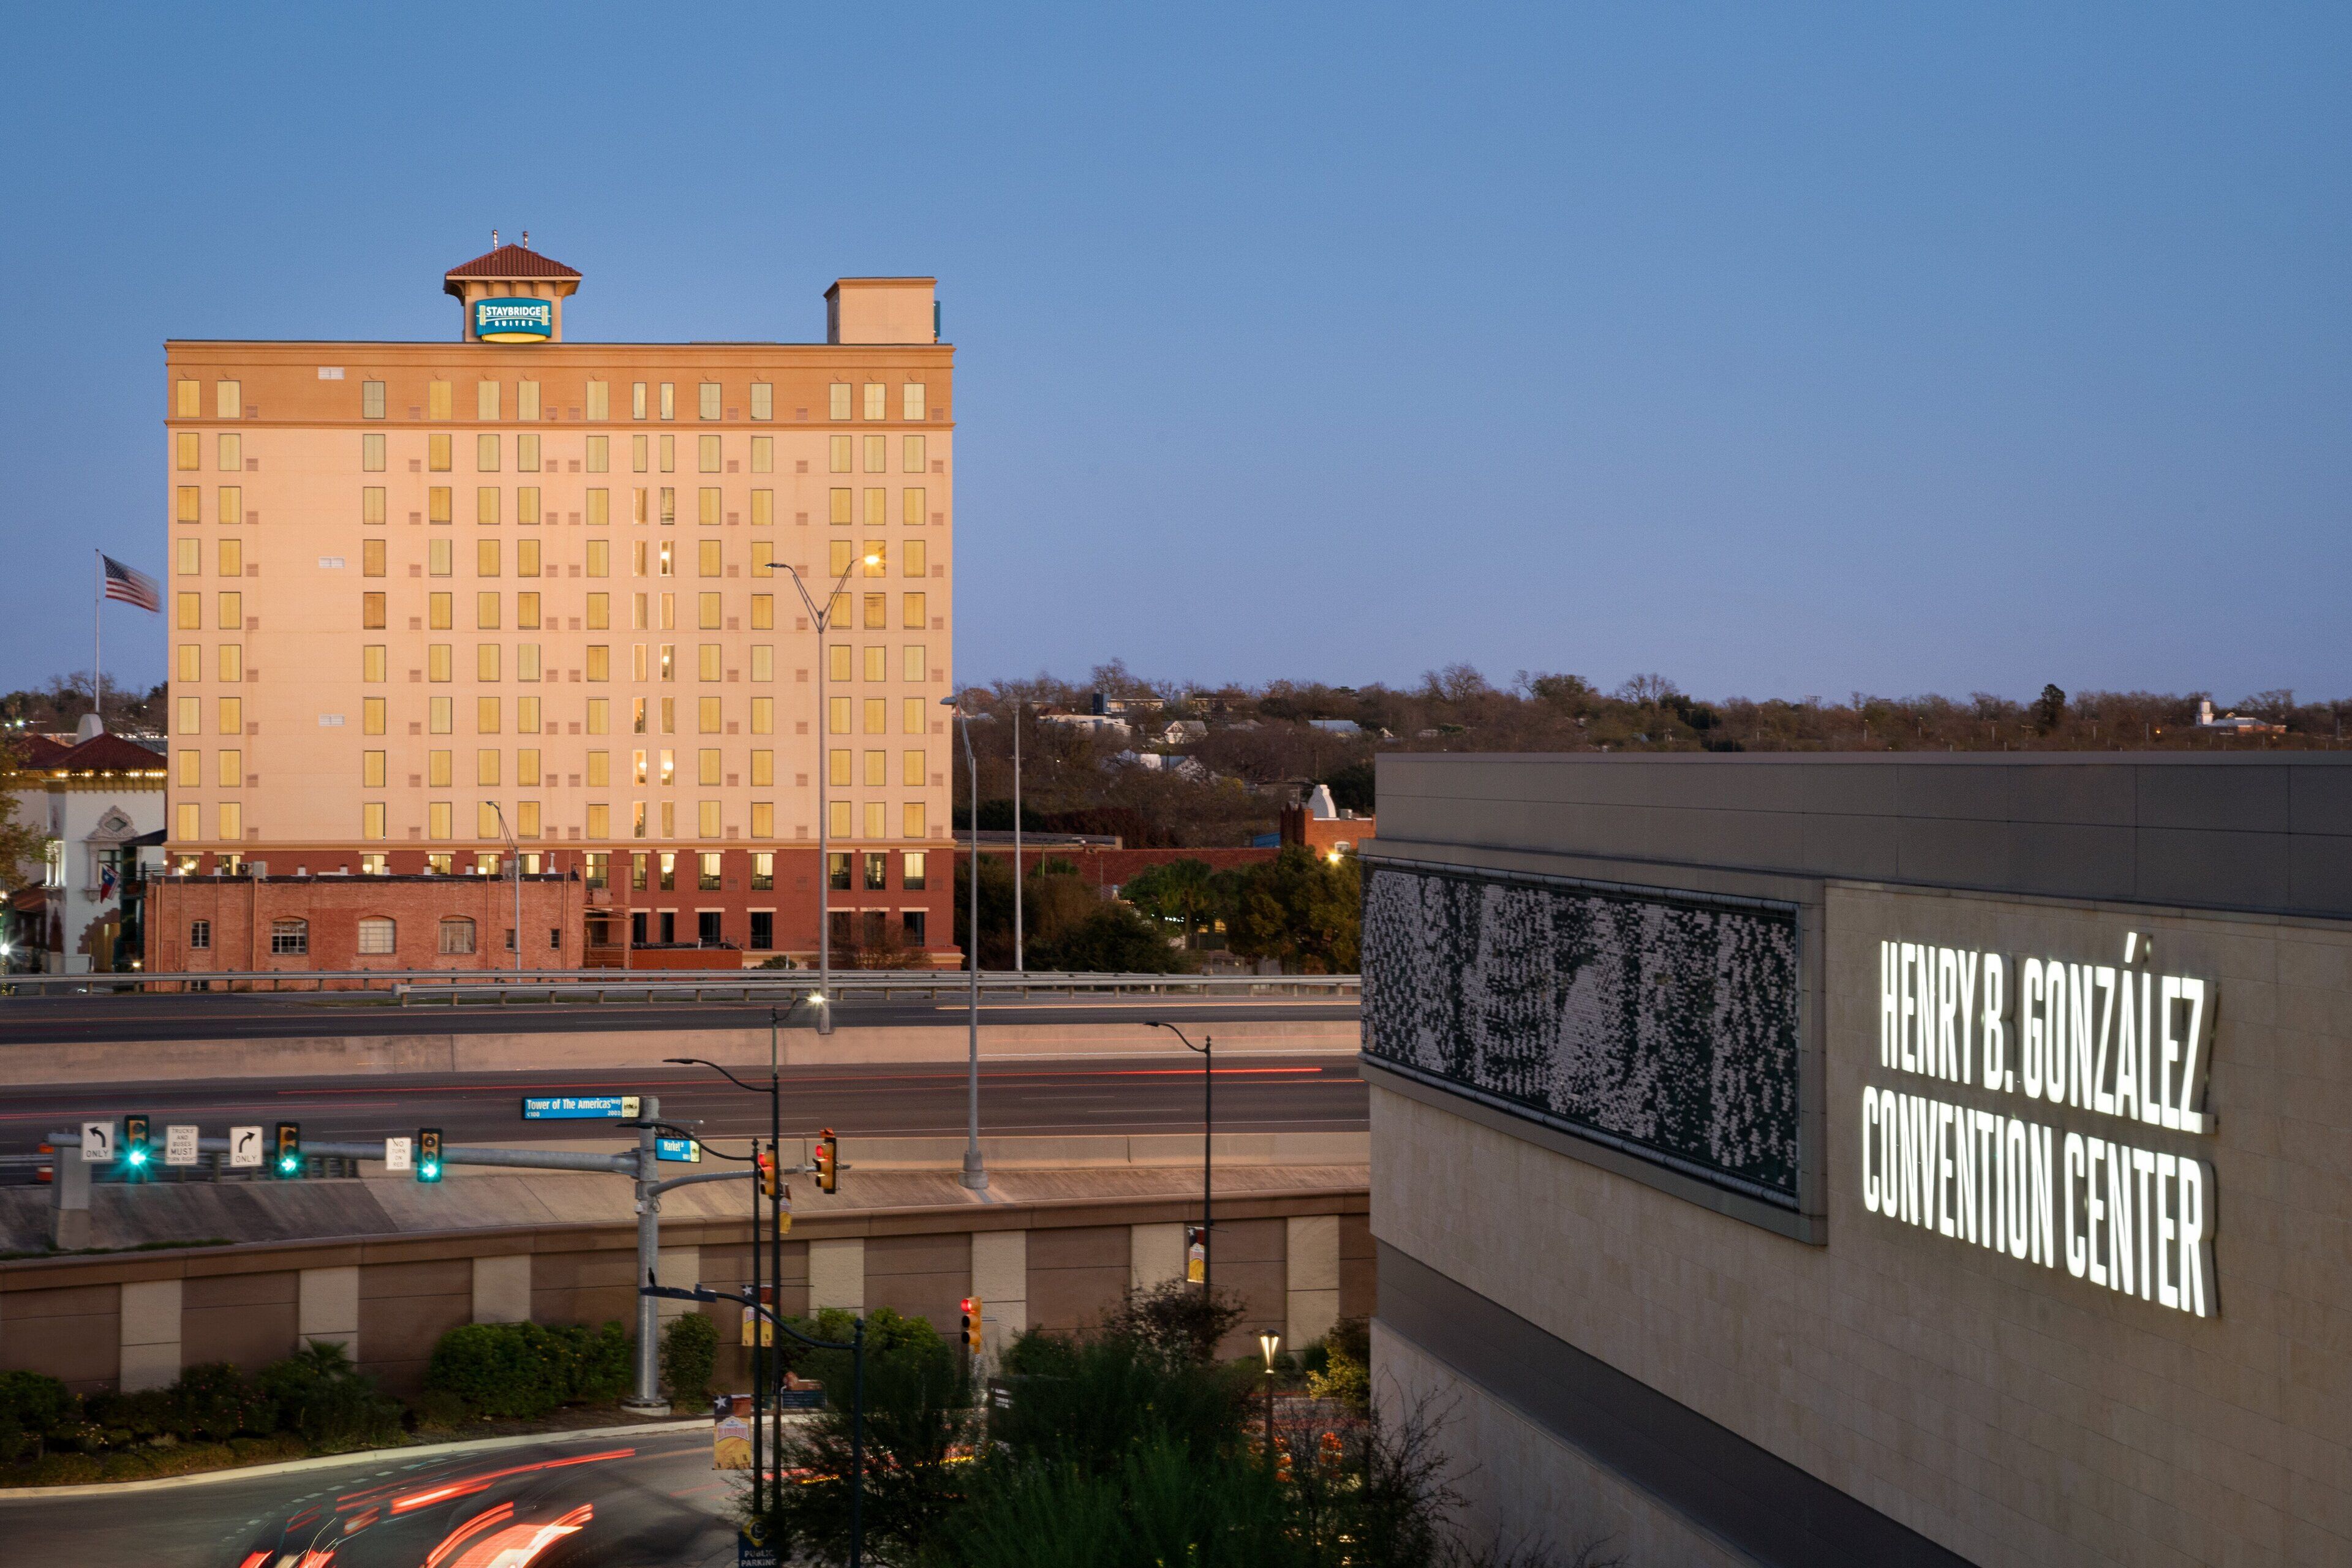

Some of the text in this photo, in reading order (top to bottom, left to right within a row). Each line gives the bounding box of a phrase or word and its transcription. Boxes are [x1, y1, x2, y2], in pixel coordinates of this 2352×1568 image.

[486, 306, 541, 315] STAYBRIDGE
[1881, 932, 2205, 1134] HENRY B. GONZÁLEZ
[527, 1099, 550, 1110] Tower
[552, 1099, 560, 1109] of
[562, 1099, 575, 1109] The
[578, 1098, 611, 1109] Americas
[663, 1140, 680, 1152] Market
[235, 1155, 257, 1163] ONLY
[1863, 1085, 2205, 1317] CONVENTION CENTER
[744, 1549, 774, 1558] PUBLIC
[741, 1558, 777, 1567] PARKING
